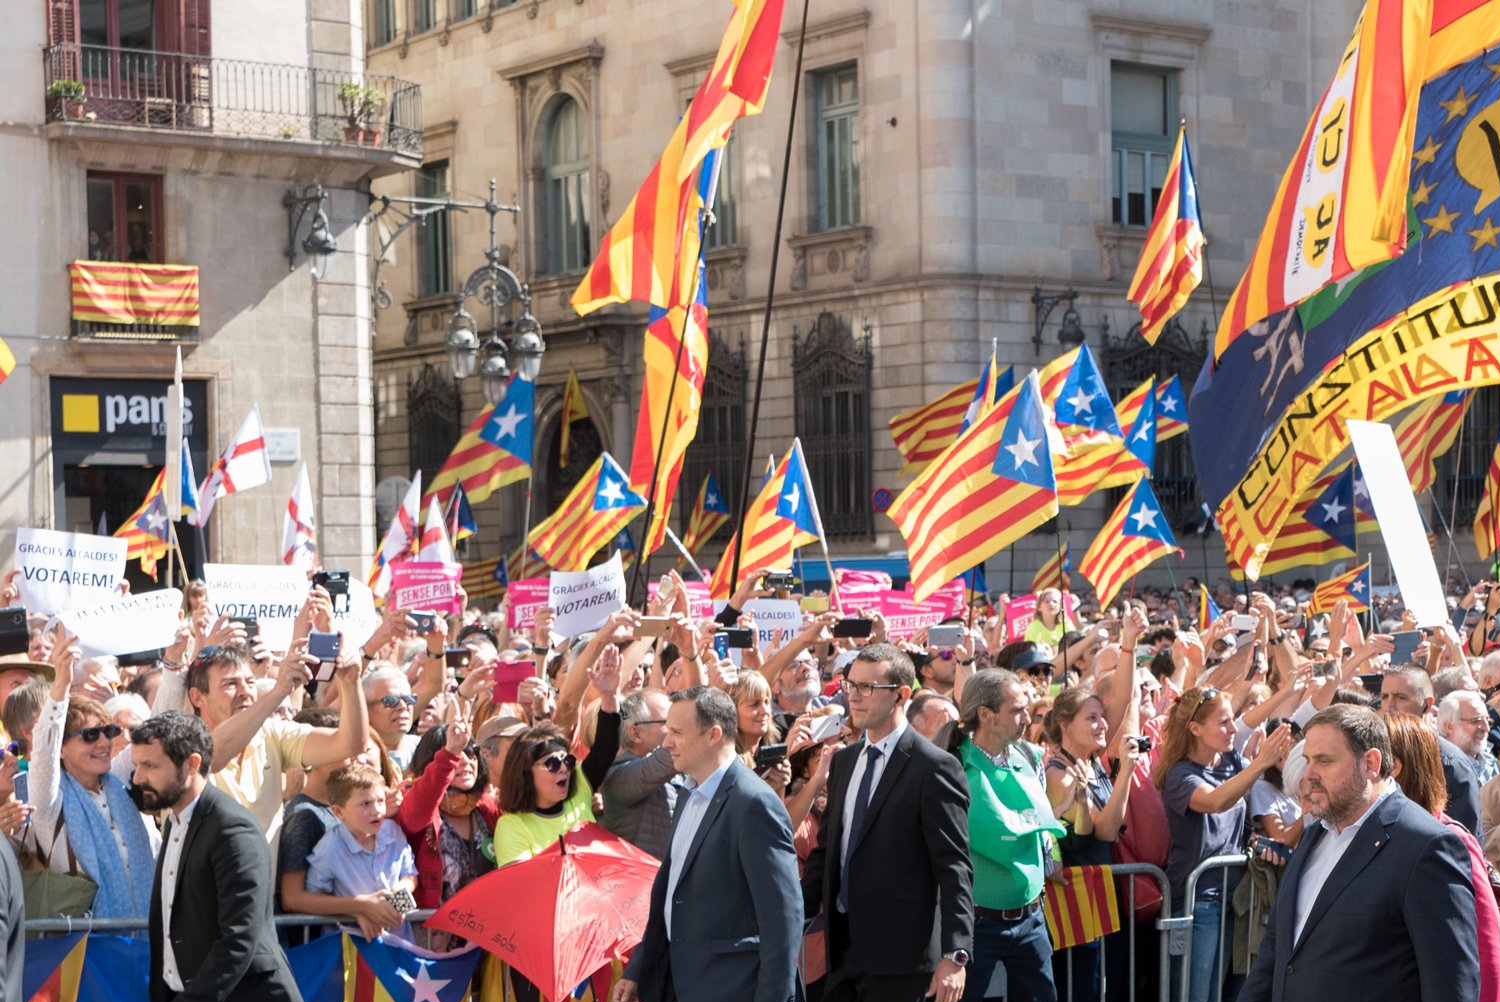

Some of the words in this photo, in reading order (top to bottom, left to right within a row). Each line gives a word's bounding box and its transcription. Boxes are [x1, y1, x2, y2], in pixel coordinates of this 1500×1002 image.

[23, 565, 115, 589] VOTAREM!
[552, 580, 589, 596] GRÀCIES
[556, 585, 621, 617] VOTAREM!
[448, 907, 485, 934] estan
[491, 931, 517, 954] sols
